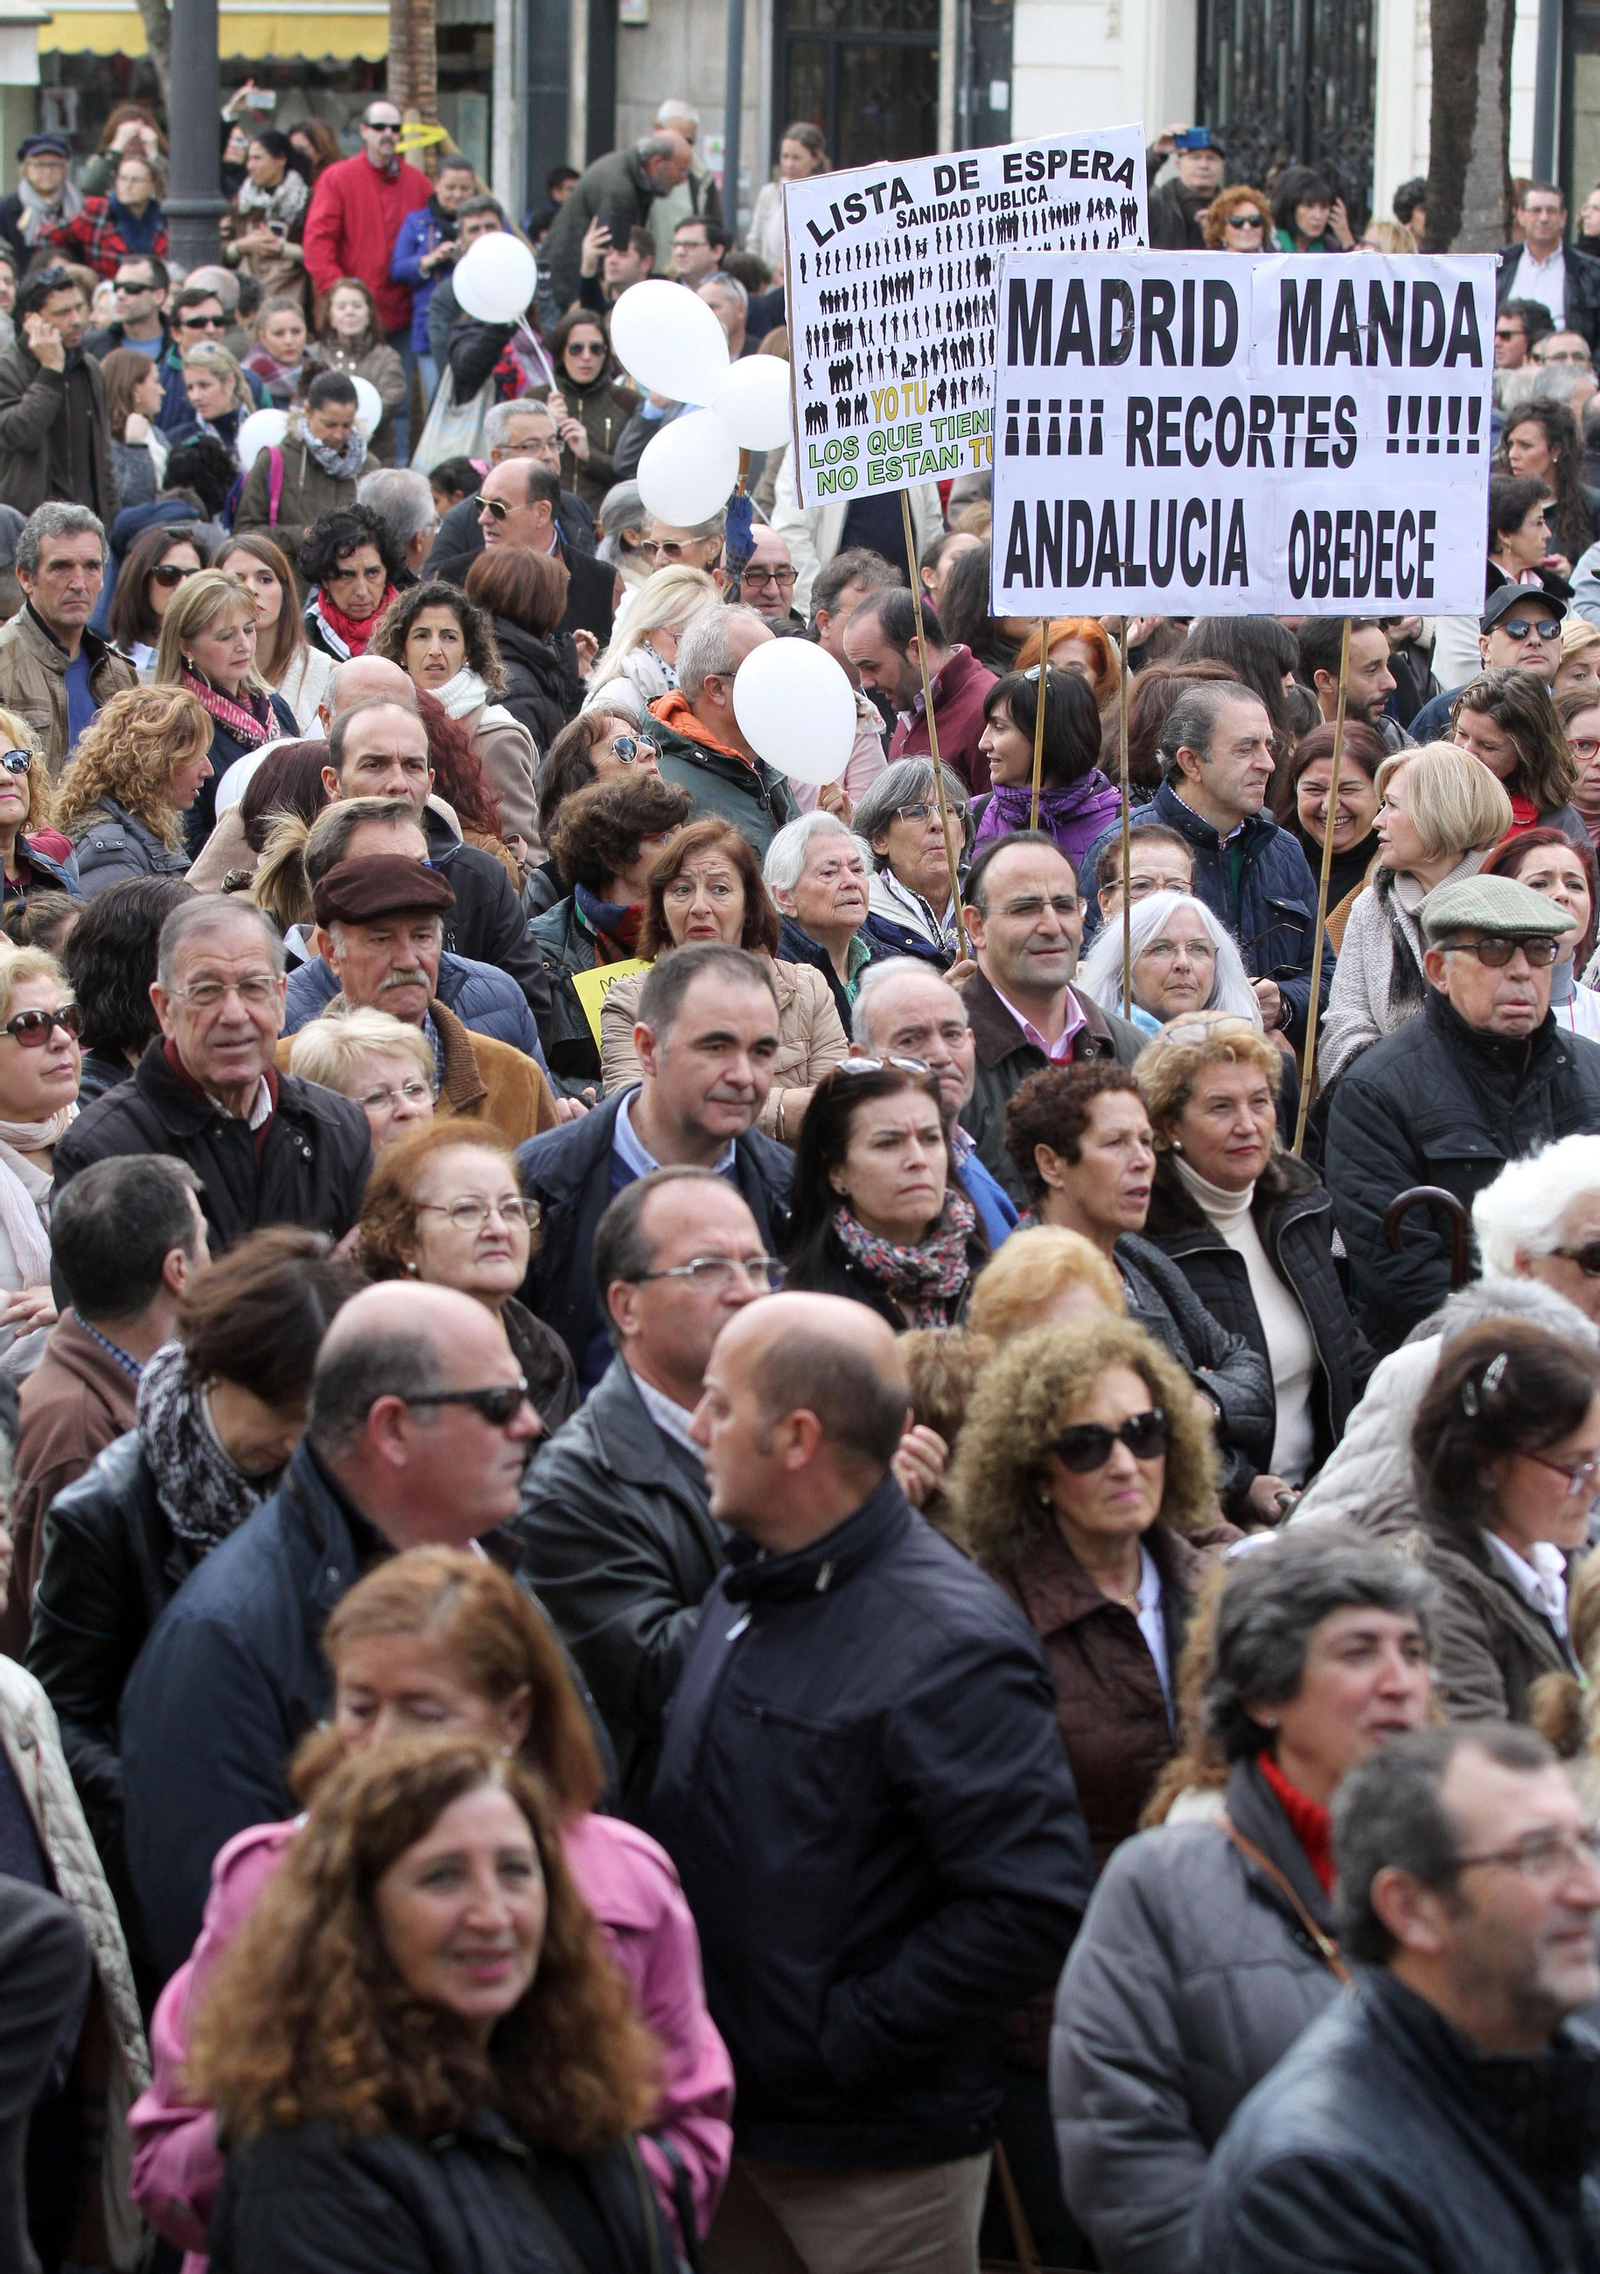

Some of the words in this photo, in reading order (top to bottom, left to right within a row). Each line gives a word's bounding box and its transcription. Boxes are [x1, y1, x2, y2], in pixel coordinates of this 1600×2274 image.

[806, 176, 914, 247] LISTA
[934, 159, 980, 197] DE
[1003, 149, 1135, 190] ESPERA
[896, 197, 971, 230] SANIDAD
[976, 184, 1049, 215] PUBLICA
[1007, 278, 1239, 367] MADRID
[1277, 278, 1483, 368] MANDA
[870, 388, 898, 424] YO
[901, 379, 928, 417] TU
[1126, 394, 1358, 469] RECORTES
[808, 435, 860, 469] LOS
[867, 422, 923, 456] QUE
[930, 407, 994, 443] TIEN
[817, 465, 859, 496] NO
[867, 444, 964, 486] ESTAN,
[1003, 498, 1249, 589] ANDALUCIA
[1288, 508, 1436, 600] OBEDECE
